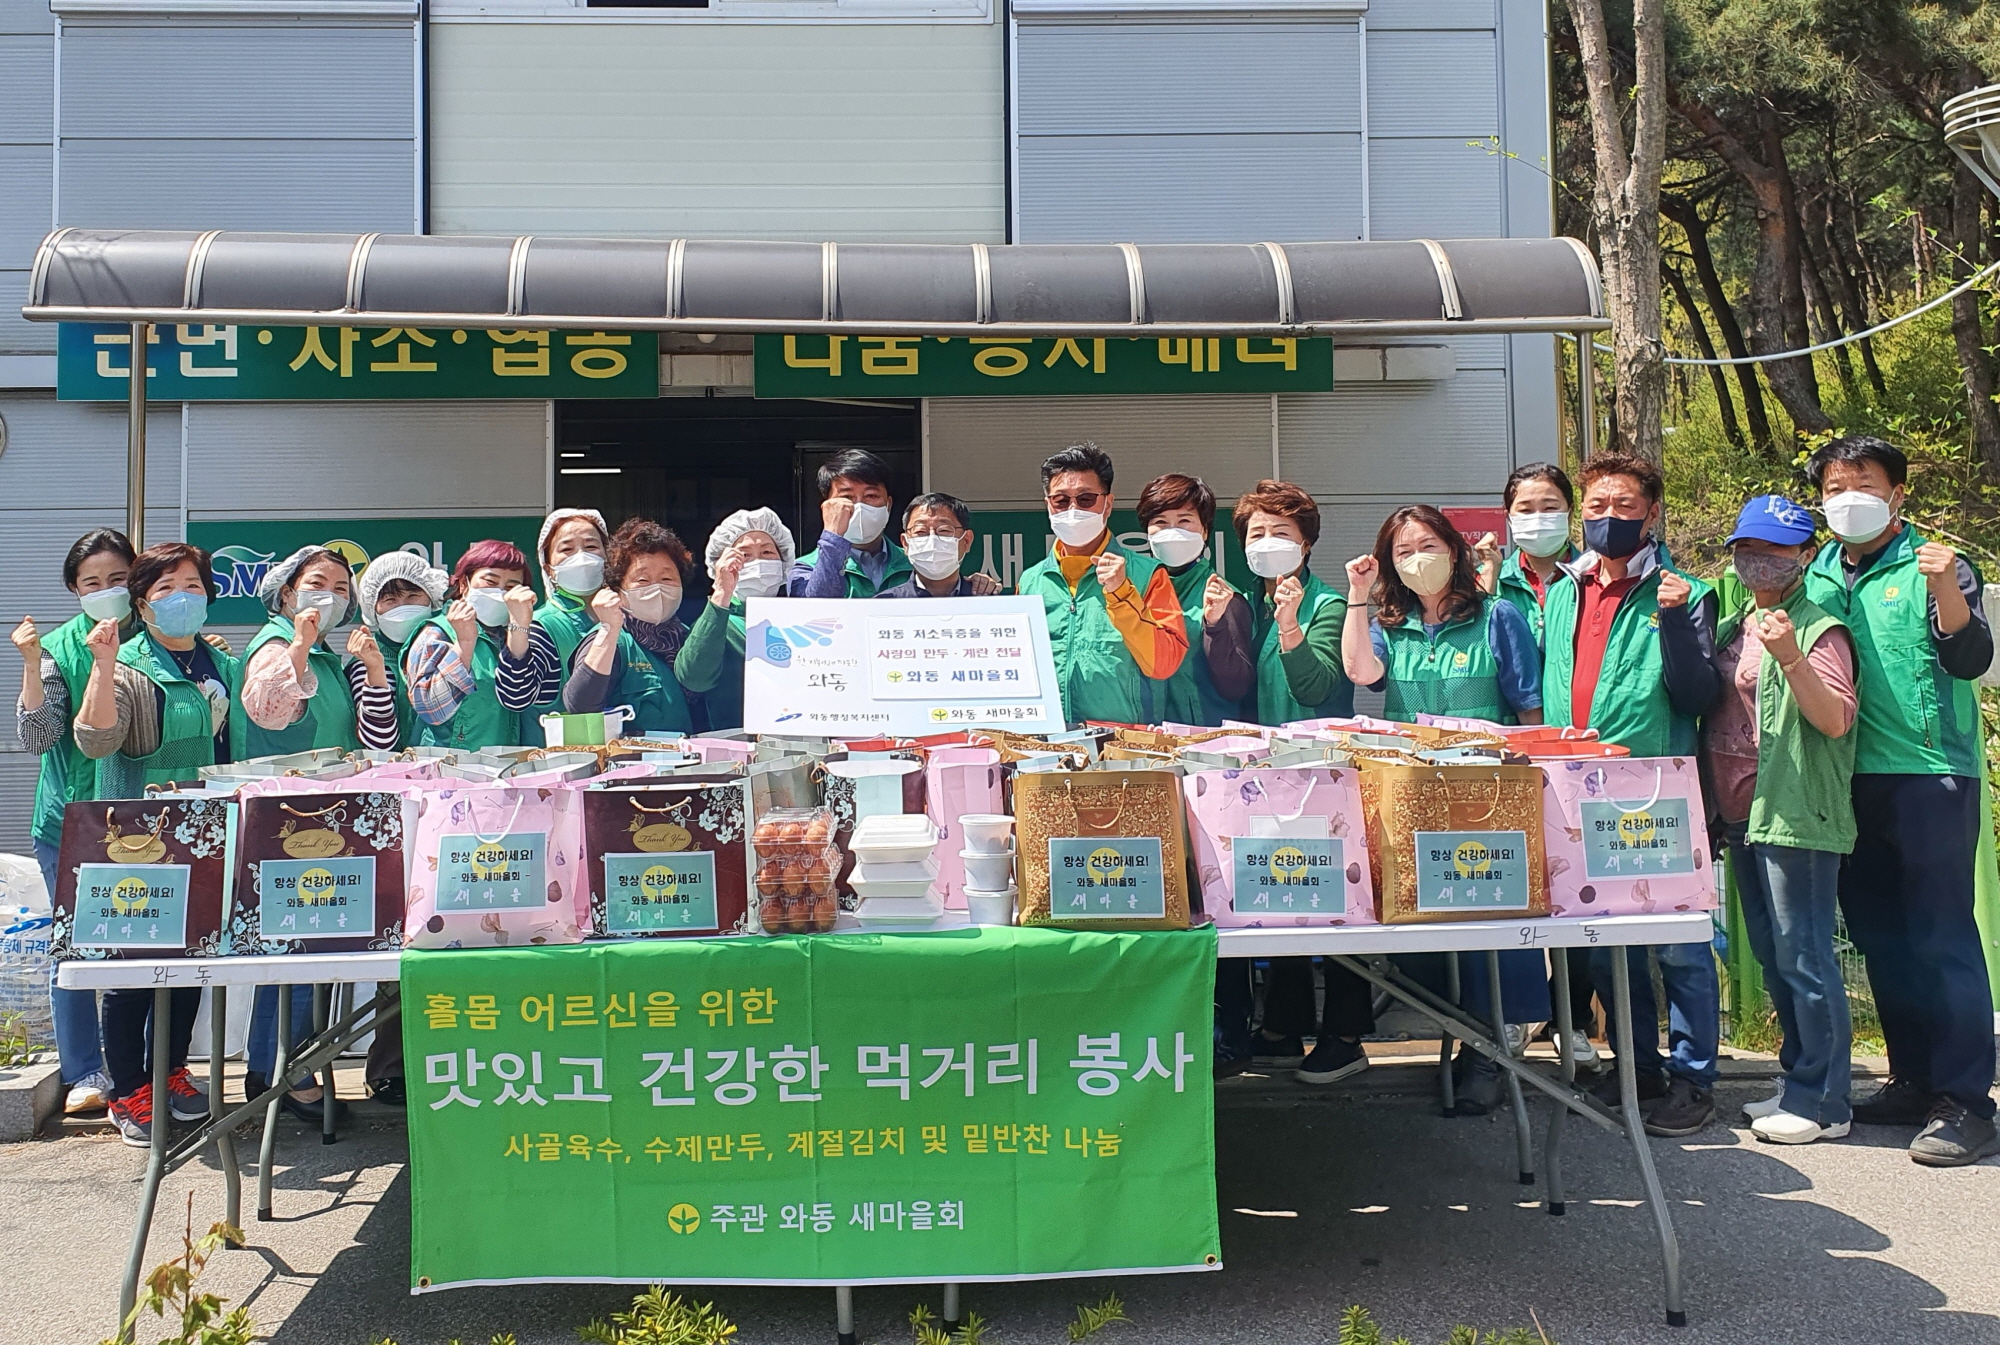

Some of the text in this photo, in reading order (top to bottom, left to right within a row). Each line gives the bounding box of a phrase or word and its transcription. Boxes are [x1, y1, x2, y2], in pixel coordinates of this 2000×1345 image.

[879, 630, 903, 639] 와동
[990, 627, 1017, 638] 위한
[878, 647, 1021, 659] 사랑의 만두 계란 전달
[908, 670, 1018, 682] 와동 새마을회
[808, 674, 848, 692] 와동
[809, 713, 890, 722] 와동행정복지센터
[951, 707, 1038, 720] 와동 새마을회
[1595, 816, 1678, 832] 항상 건강하세요!
[288, 838, 341, 856] Thank You
[639, 833, 687, 851] Thank You
[1609, 838, 1668, 851] 와동 새마을회
[450, 849, 533, 864] 항상 건강하세요!
[1063, 855, 1148, 868] 항상 건강하세요!
[1246, 854, 1331, 867] 항상 건강하세요!
[1430, 848, 1514, 862] 항상 건강하세요!
[274, 874, 360, 889] 항상 건강하세요!
[461, 871, 520, 883] 와동 새마을회
[618, 872, 701, 887] 항상 건강하세요!
[1259, 875, 1320, 887] 와동 새마을회
[1443, 870, 1502, 881] 와동 새마을회
[1076, 877, 1137, 888] 와동 새마을회
[90, 886, 174, 899] 항상 건강하세요!
[286, 896, 347, 908] 와동 새마을회
[631, 893, 690, 906] 와동 새마을회
[100, 907, 160, 919] 와동 새마을회
[423, 987, 779, 1032] 홀몸 어르신을 위한
[425, 1031, 1195, 1111] 맛있고 건강한 먹거리 봉사
[503, 1123, 1123, 1164] 사골육수, 수제만두, 계절김치 및 밑반찬 나눔
[710, 1200, 965, 1233] 주관 와동 새마을회
